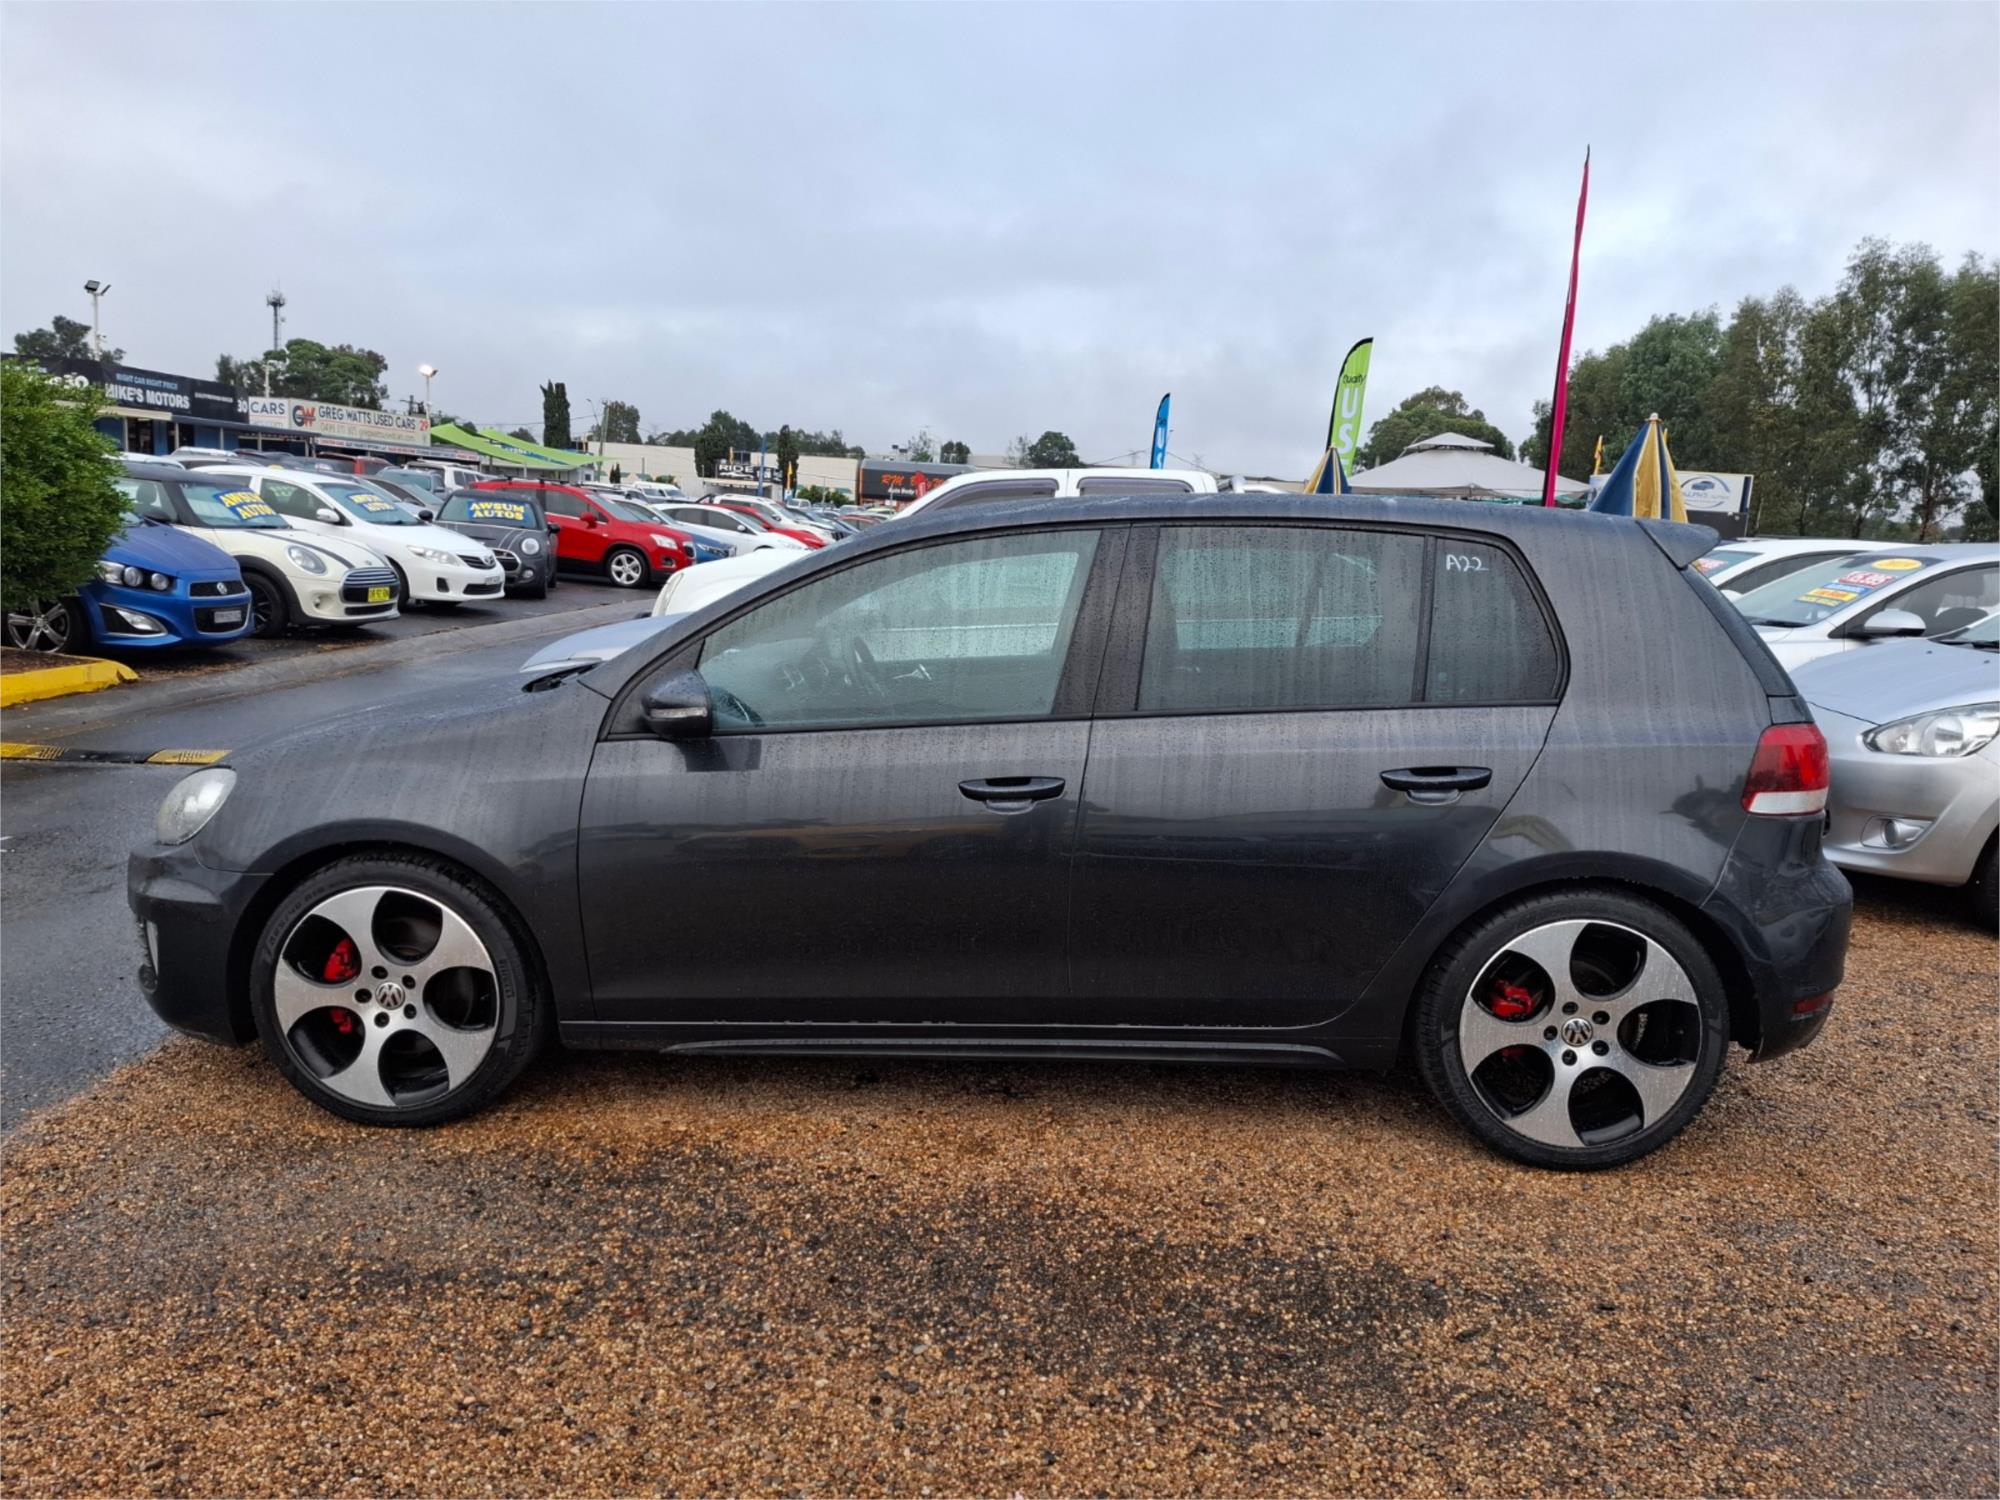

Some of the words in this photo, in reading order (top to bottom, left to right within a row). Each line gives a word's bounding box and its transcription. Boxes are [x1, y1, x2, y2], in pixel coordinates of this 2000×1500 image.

[145, 389, 191, 410] MOTORS
[250, 401, 286, 415] CARS
[318, 405, 345, 420] GREG
[345, 409, 372, 425] WATTS
[373, 412, 394, 427] USED
[395, 416, 416, 430] CARS
[418, 419, 429, 432] 29
[718, 464, 755, 473] RIDE
[469, 501, 525, 513] AWSUM
[472, 510, 524, 521] AUTOS
[1446, 554, 1489, 572] A22
